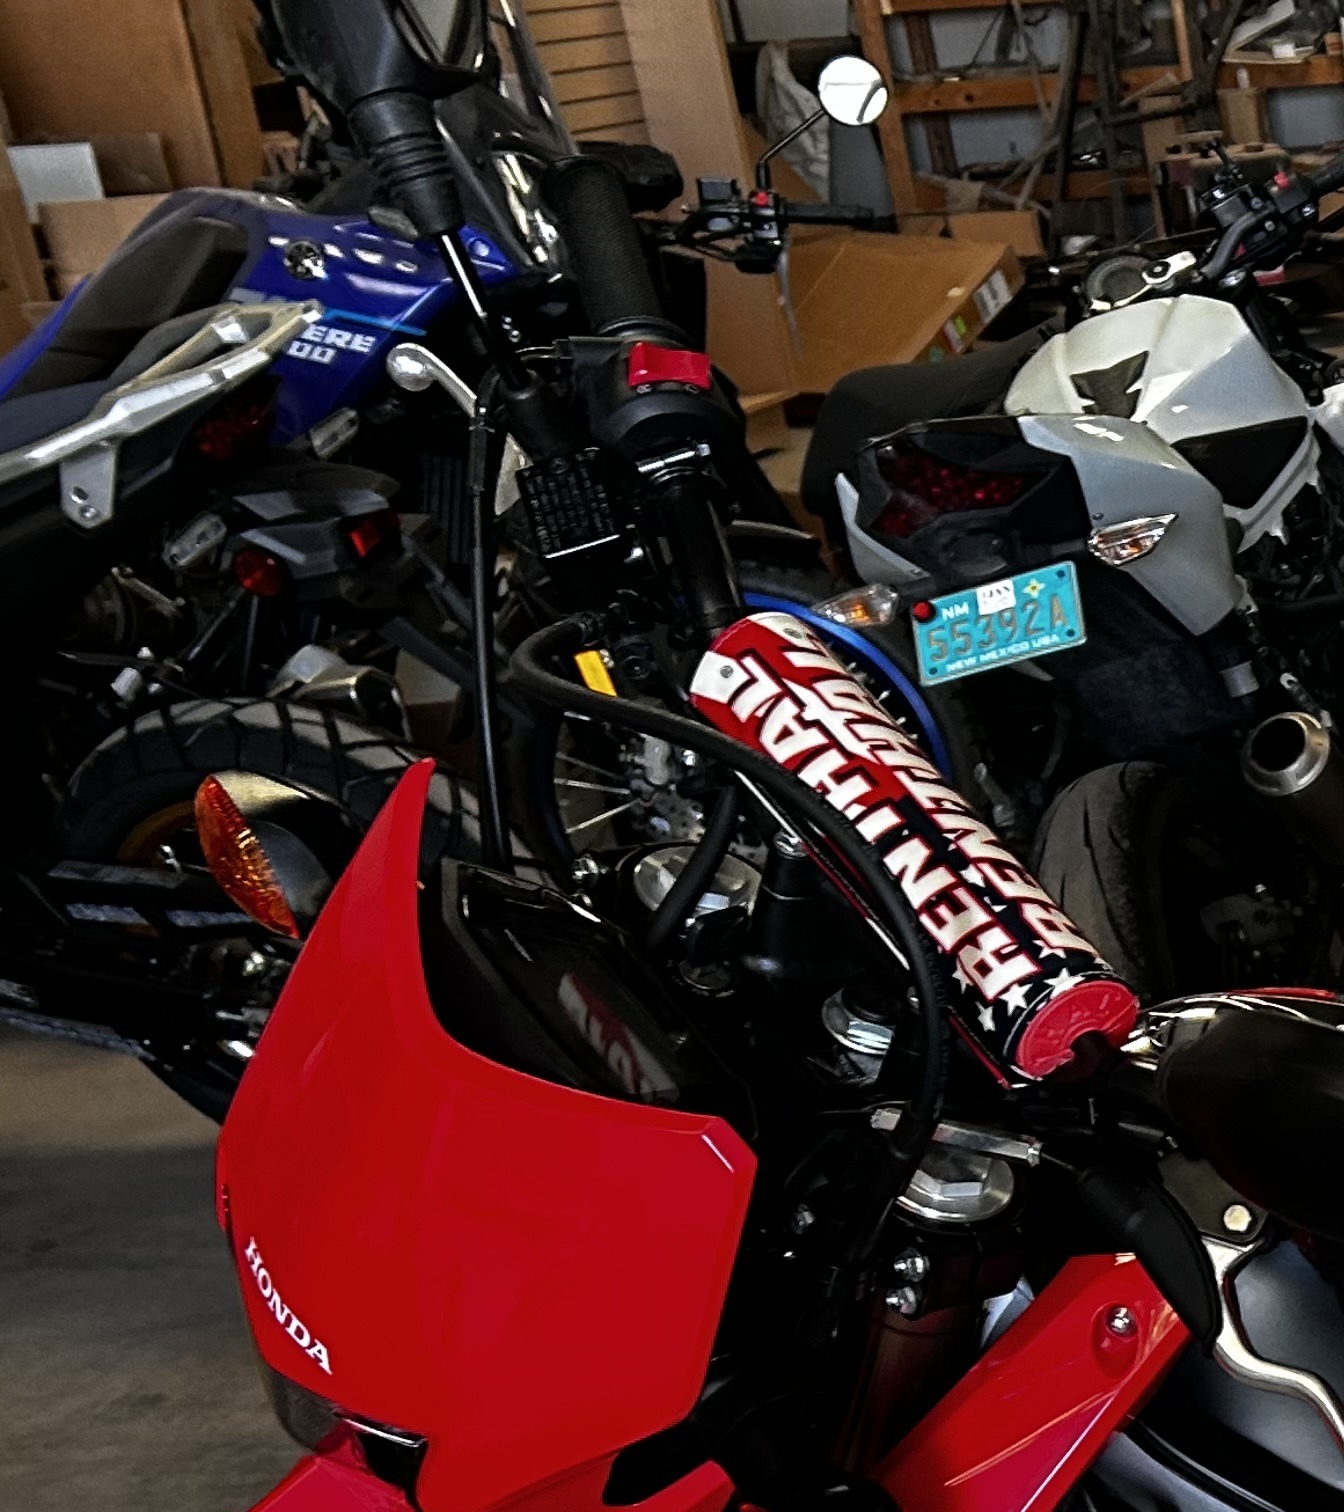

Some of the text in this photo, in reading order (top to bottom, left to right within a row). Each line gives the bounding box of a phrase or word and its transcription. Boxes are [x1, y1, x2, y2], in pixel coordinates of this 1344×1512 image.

[926, 594, 1068, 662] 55392A
[941, 602, 969, 620] NM
[946, 634, 1060, 672] NEW MEXICO USA
[731, 654, 1042, 1001] RENTHAL
[245, 1236, 333, 1375] HONDA
